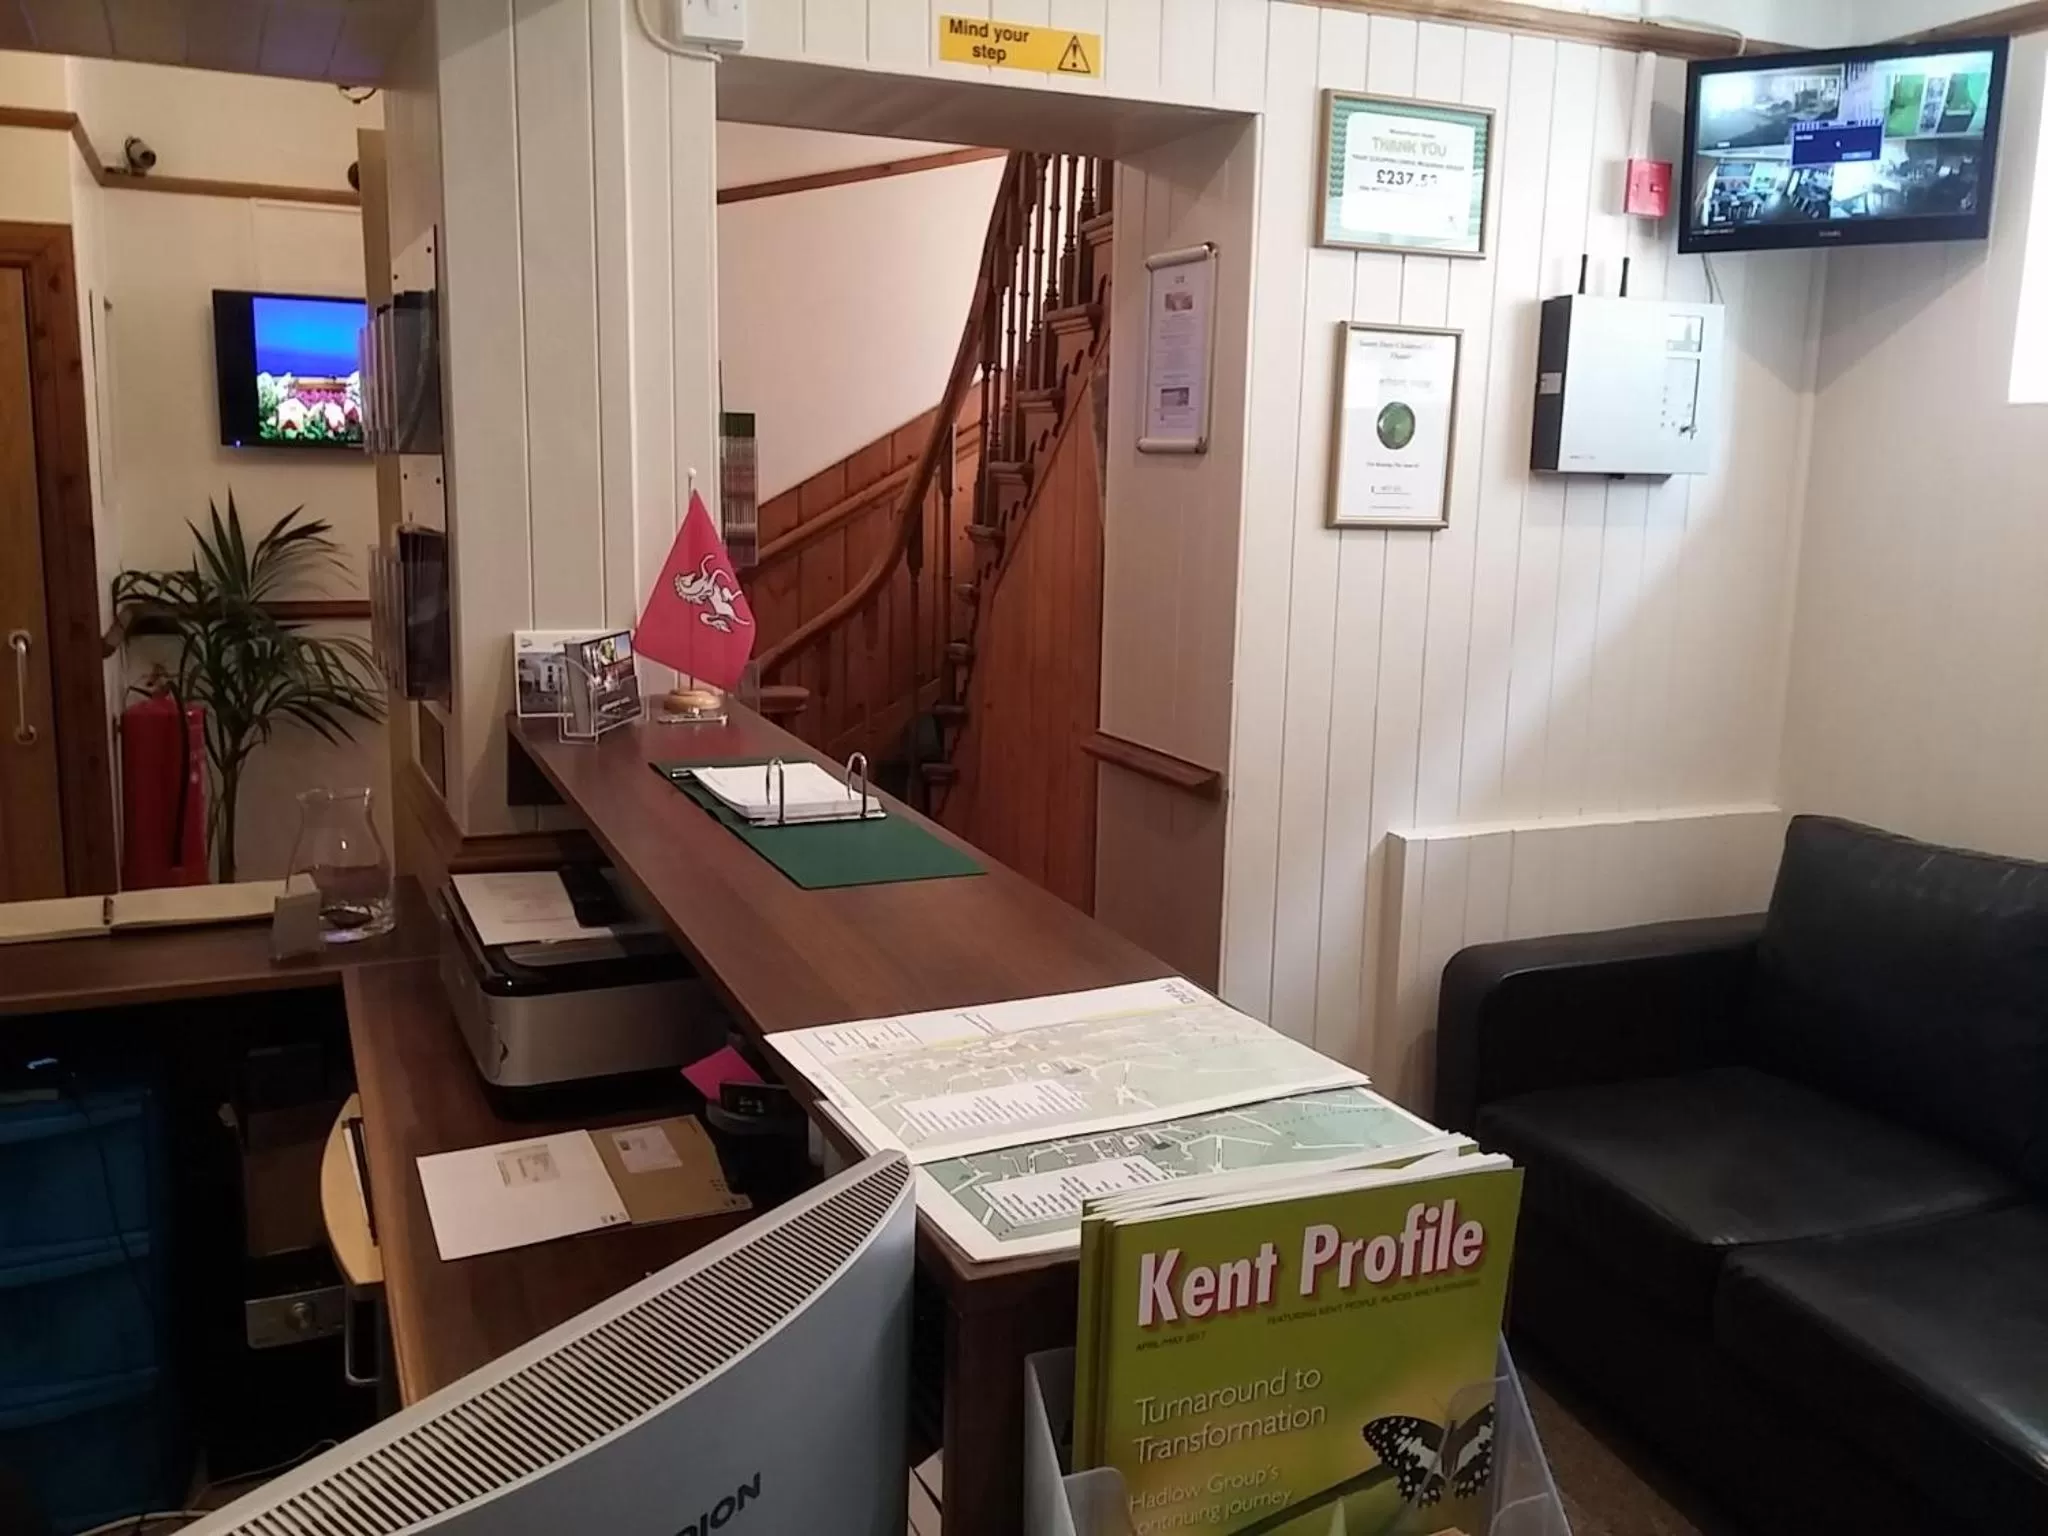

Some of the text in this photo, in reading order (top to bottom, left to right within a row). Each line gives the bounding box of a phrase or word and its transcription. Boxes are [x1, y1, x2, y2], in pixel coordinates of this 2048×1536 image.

[949, 18, 1030, 44] Mind your
[972, 45, 1007, 64] step
[1372, 136, 1447, 158] THANK YOU
[1138, 1199, 1484, 1328] Kent Profile
[1135, 1367, 1322, 1427] Turnaround to
[1132, 1404, 1326, 1464] Transformation
[1129, 1483, 1200, 1515] Hadlow
[1137, 1488, 1292, 1536] ontinuing journey
